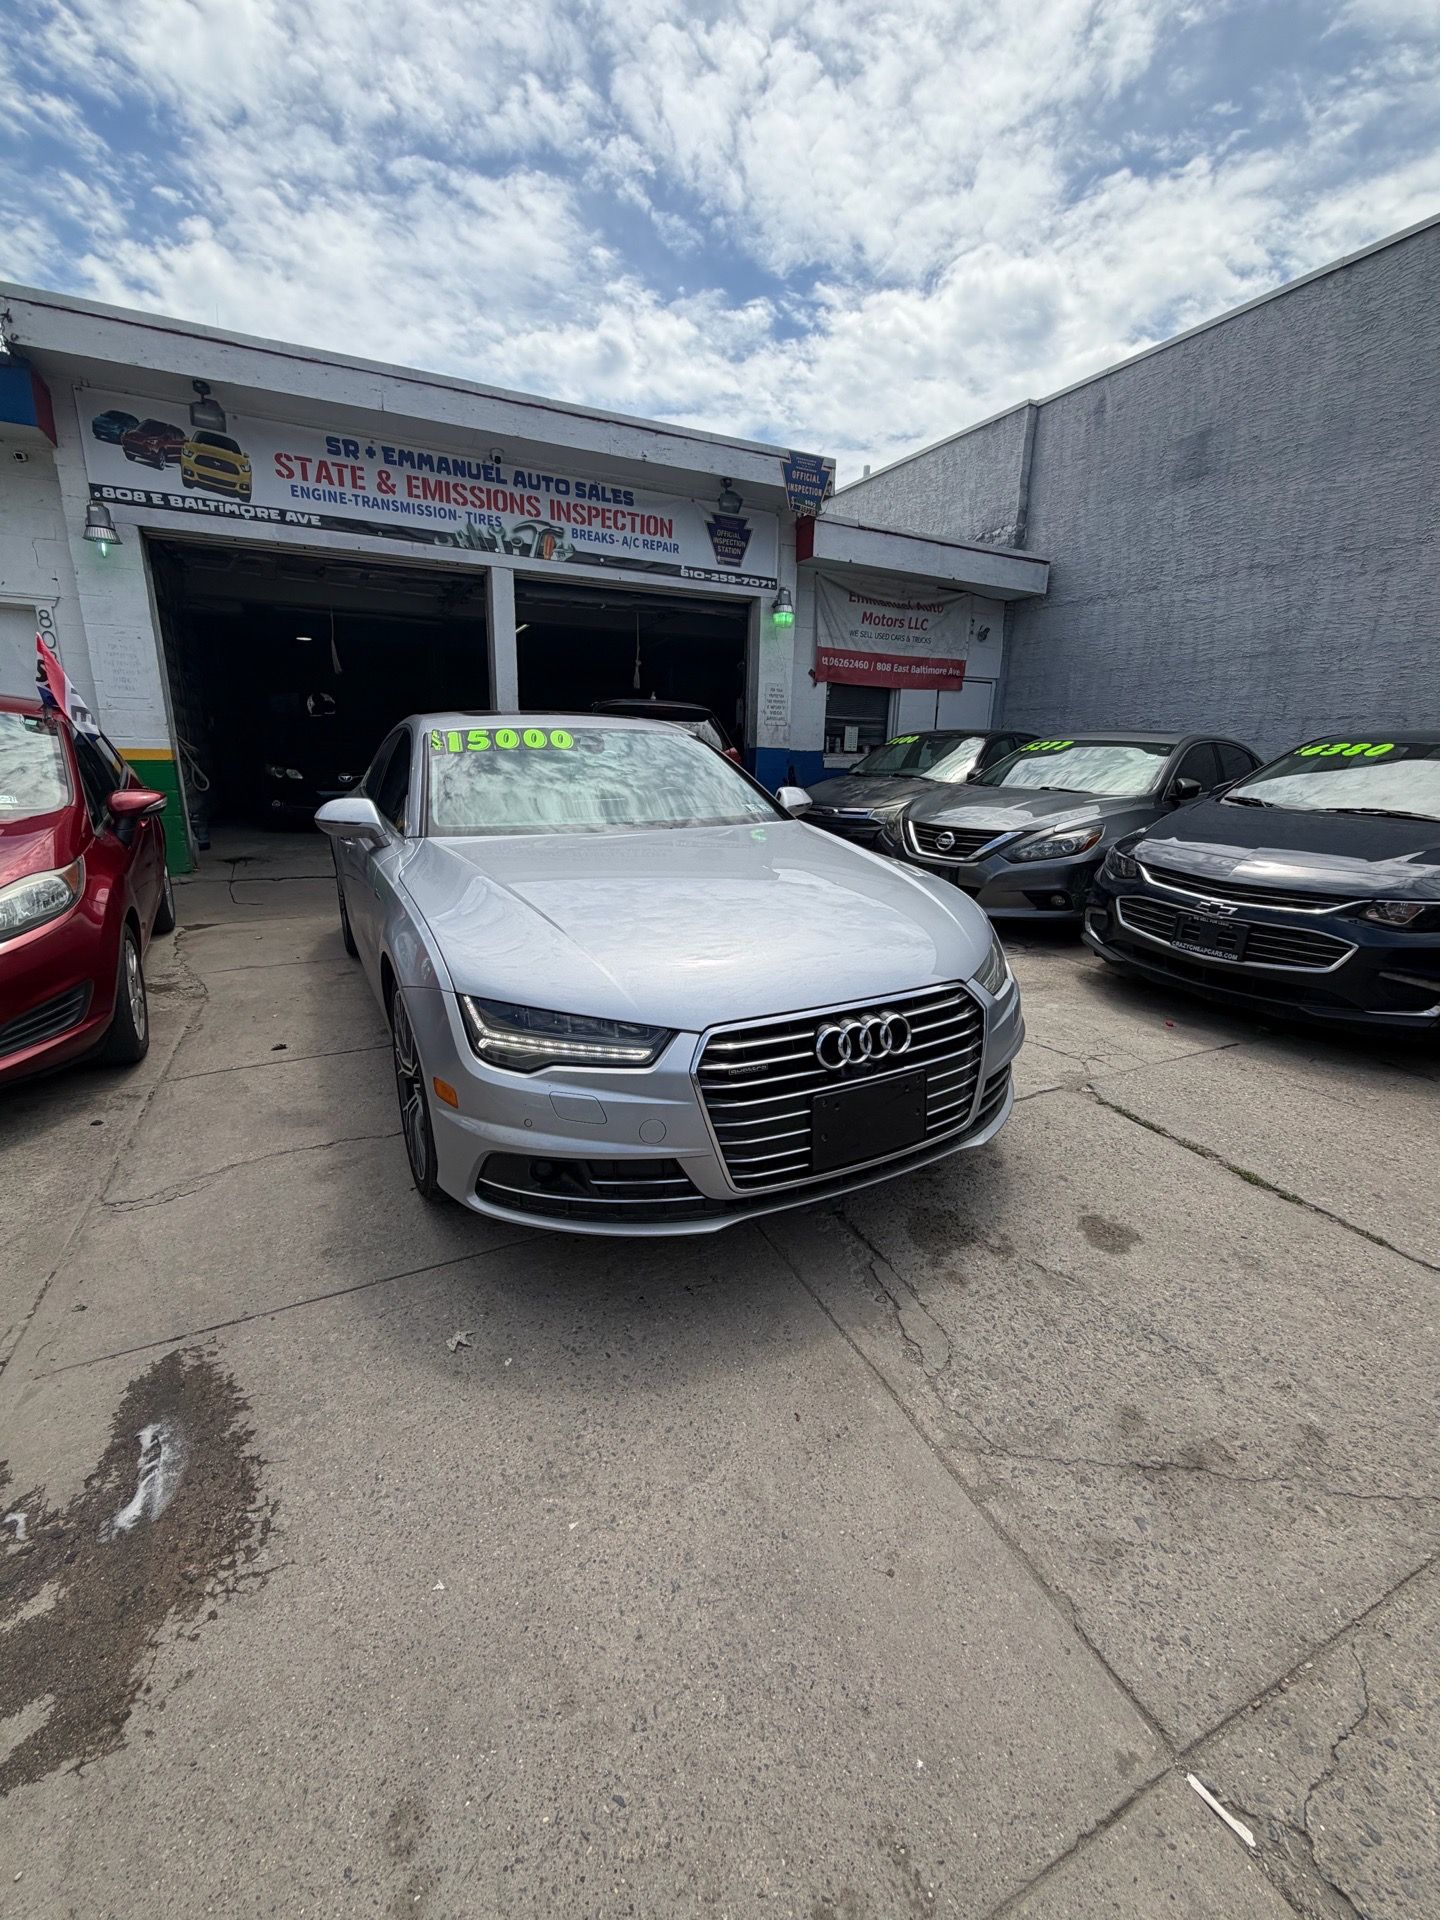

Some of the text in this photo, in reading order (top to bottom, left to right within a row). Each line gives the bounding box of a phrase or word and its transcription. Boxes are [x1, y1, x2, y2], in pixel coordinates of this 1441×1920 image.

[326, 436, 359, 460] SR
[381, 446, 508, 484] EMMANUEL
[513, 470, 571, 496] AUTO
[574, 481, 634, 507] SALES
[792, 470, 820, 483] OFFICIAL
[274, 452, 673, 539] STATE & EMISSIONS INSPECTION
[787, 482, 823, 496] INSPECTION
[102, 487, 146, 503] 808
[150, 493, 164, 504] E
[285, 511, 321, 526] AVE
[465, 511, 502, 527] TIRES
[713, 537, 746, 548] INSPECTION
[717, 529, 741, 539] OFFICIAL
[622, 536, 640, 550] A/C
[642, 538, 680, 554] REPAIR
[718, 546, 741, 555] STATION
[680, 569, 772, 589] 610-259-7071
[861, 611, 929, 631] Motors LLC
[849, 629, 859, 637] WE
[860, 630, 873, 639] SELL
[874, 632, 890, 641] USED
[890, 634, 905, 642] CARS
[912, 635, 932, 645] TRUCKS
[876, 662, 892, 672] 808
[893, 663, 909, 673] East
[911, 665, 947, 675] Baltimore
[431, 729, 574, 753] $15000
[1171, 940, 1239, 961] CRAZYCHEAPCARS.COM
